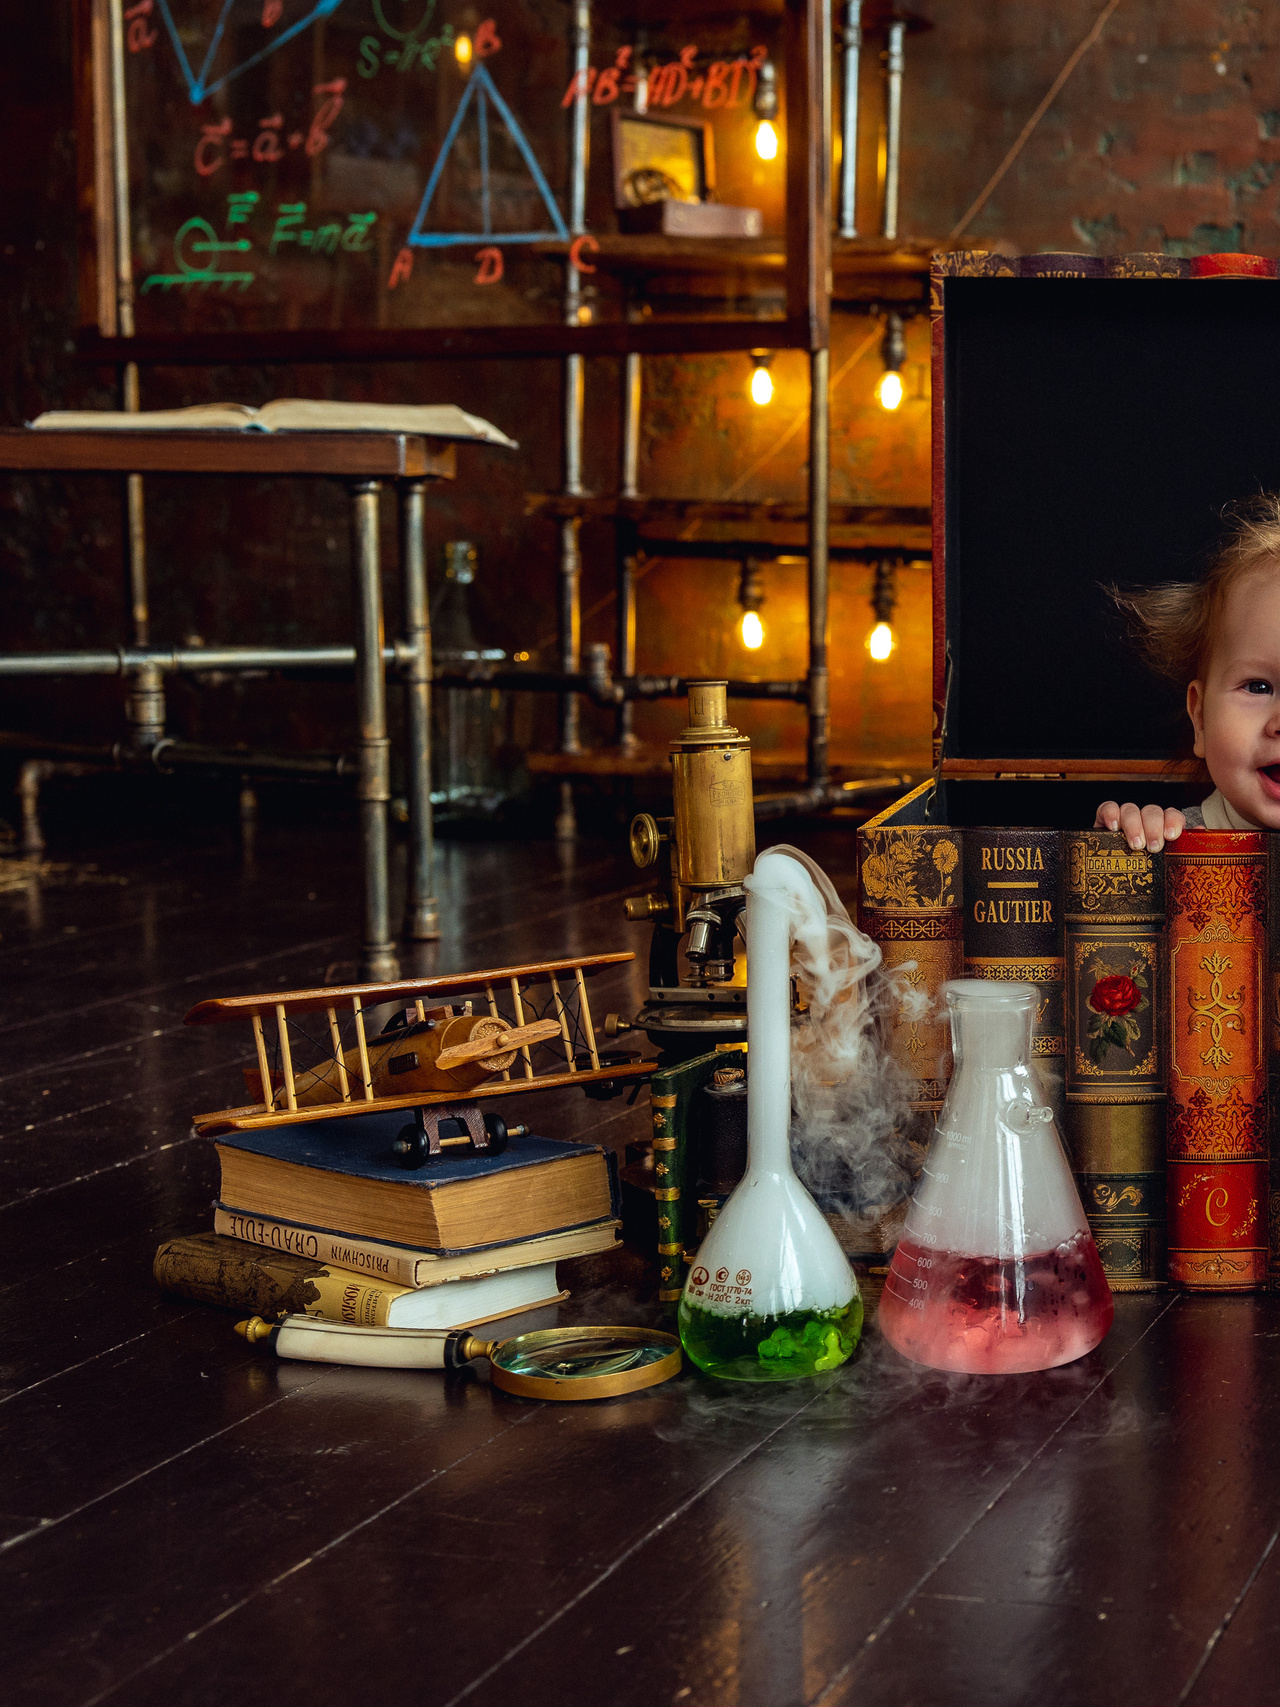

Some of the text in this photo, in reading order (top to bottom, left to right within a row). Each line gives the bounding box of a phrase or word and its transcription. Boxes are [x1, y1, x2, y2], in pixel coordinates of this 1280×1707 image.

[981, 847, 1044, 871] RUSSIA
[974, 900, 1053, 923] GAUTIER
[945, 1131, 961, 1143] 1000
[935, 1173, 949, 1184] 900
[927, 1206, 942, 1217] 800
[229, 1215, 389, 1273] PRISCHWIN GRAU-EULE
[923, 1233, 937, 1244] 700
[917, 1257, 932, 1269] 600
[710, 1283, 752, 1295] ГОСТ 1770-74
[912, 1279, 928, 1290] 500
[908, 1298, 924, 1310] 400
